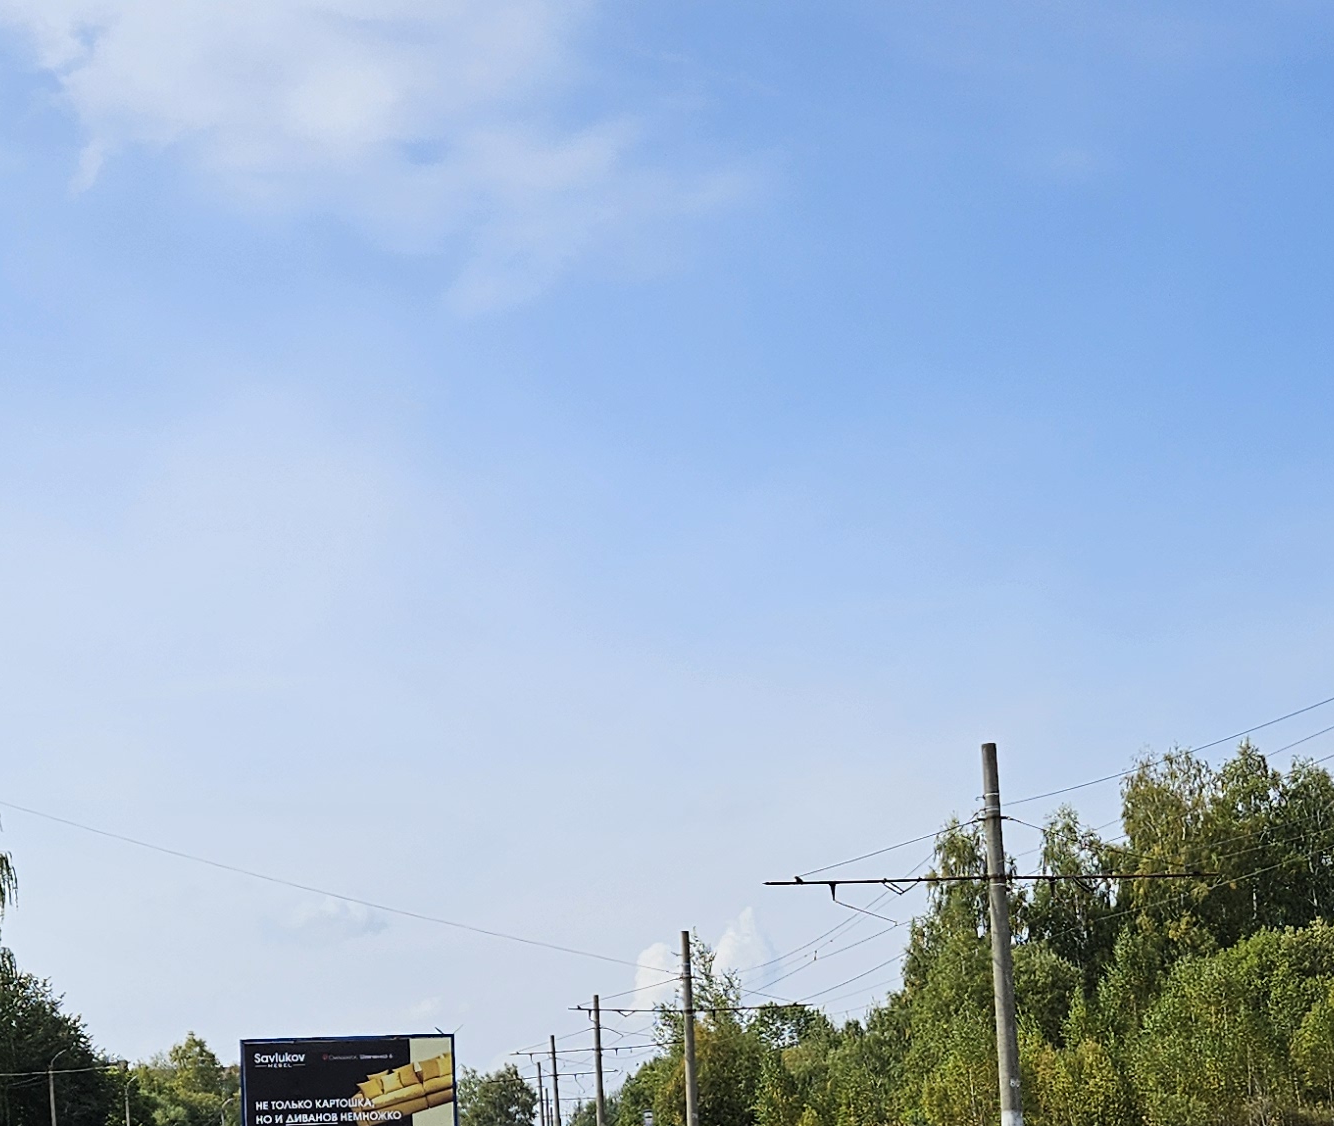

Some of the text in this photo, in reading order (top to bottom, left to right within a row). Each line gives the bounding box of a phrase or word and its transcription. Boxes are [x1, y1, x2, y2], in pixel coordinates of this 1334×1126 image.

[254, 1052, 305, 1064] Savlukov
[255, 1098, 375, 1111] НЕ ТОЛЬКО КАРТОШКА,
[255, 1110, 402, 1125] НО И ДИВАНОВ НЕМНОЖКО
